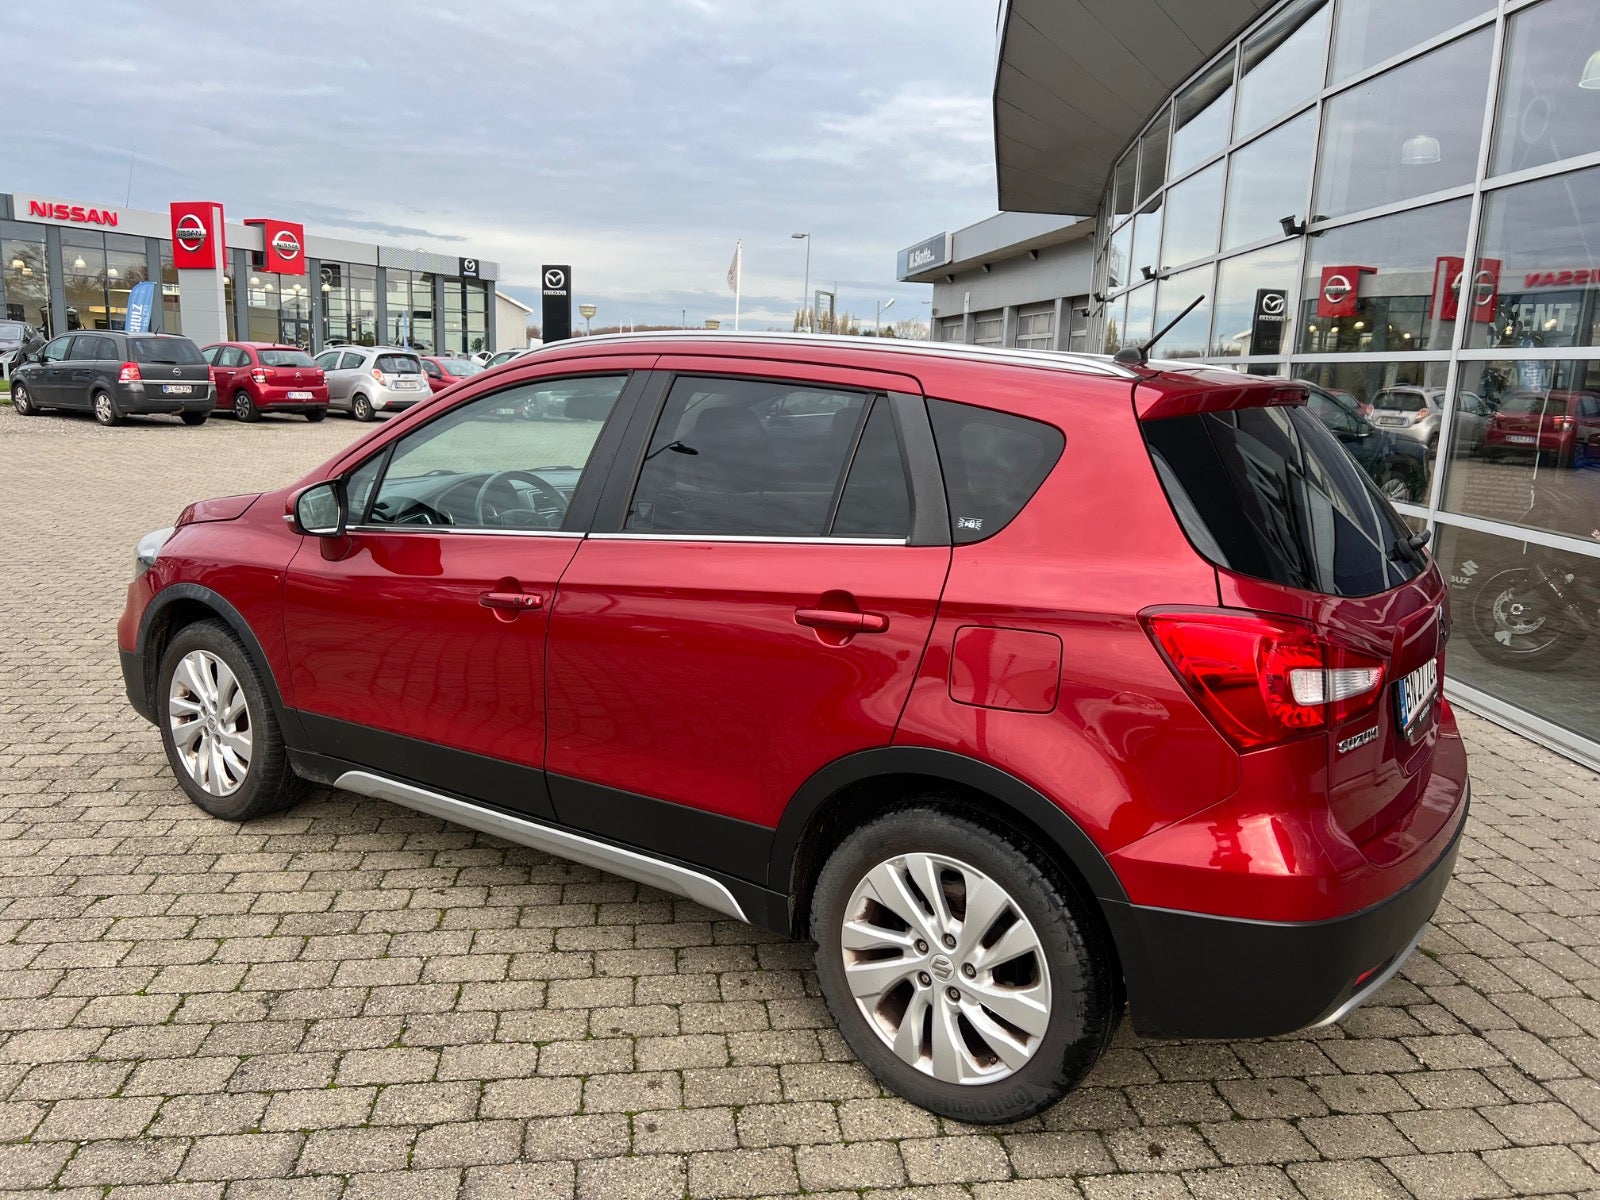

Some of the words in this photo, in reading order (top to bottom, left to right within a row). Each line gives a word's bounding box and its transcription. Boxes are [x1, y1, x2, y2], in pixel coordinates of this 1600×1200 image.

[29, 200, 118, 227] NISSAN
[276, 241, 299, 250] NISSAN
[1338, 726, 1379, 753] SUZUKI
